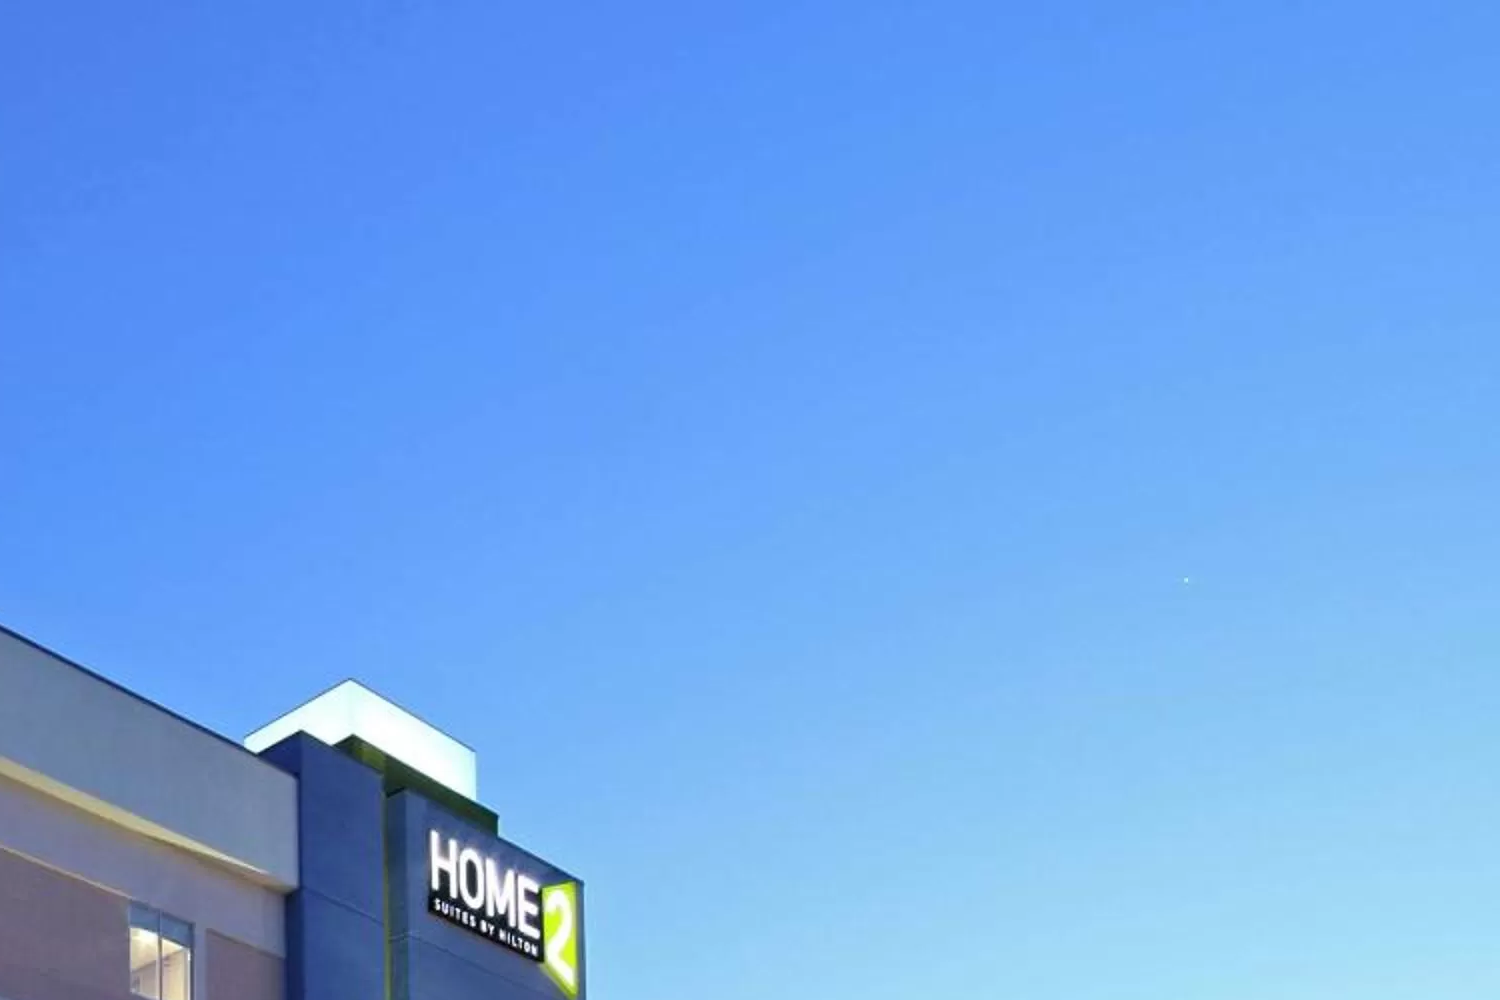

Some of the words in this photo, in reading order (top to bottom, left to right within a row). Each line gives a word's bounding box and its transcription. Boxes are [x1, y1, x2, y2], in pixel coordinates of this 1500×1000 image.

[434, 898, 477, 928] SUITES
[480, 919, 495, 936] BY
[499, 928, 539, 957] HILTON
